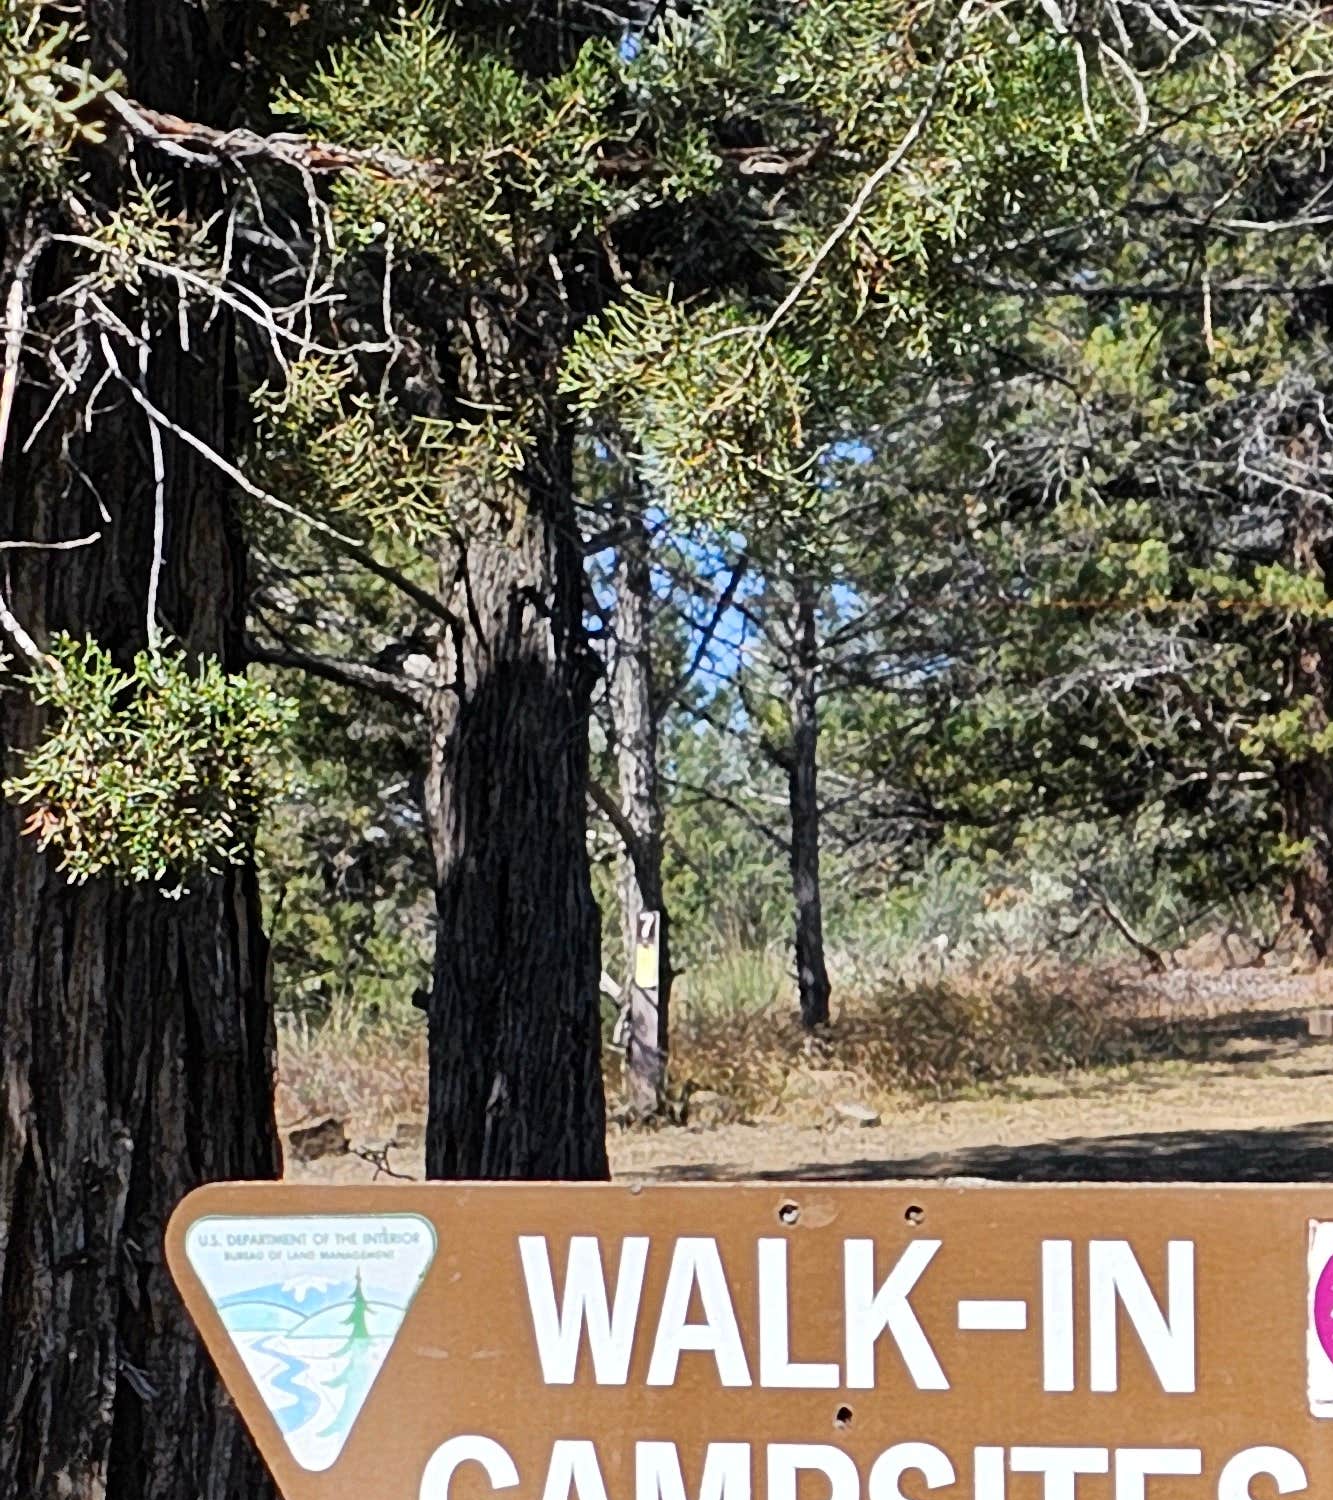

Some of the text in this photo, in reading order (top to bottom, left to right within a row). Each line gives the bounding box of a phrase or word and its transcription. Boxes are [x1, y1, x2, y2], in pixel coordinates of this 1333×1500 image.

[639, 912, 655, 938] 7
[227, 1233, 306, 1246] DEPARTMENT
[312, 1232, 329, 1245] OF
[335, 1232, 357, 1245] THE
[518, 1235, 1197, 1393] WALK-IN
